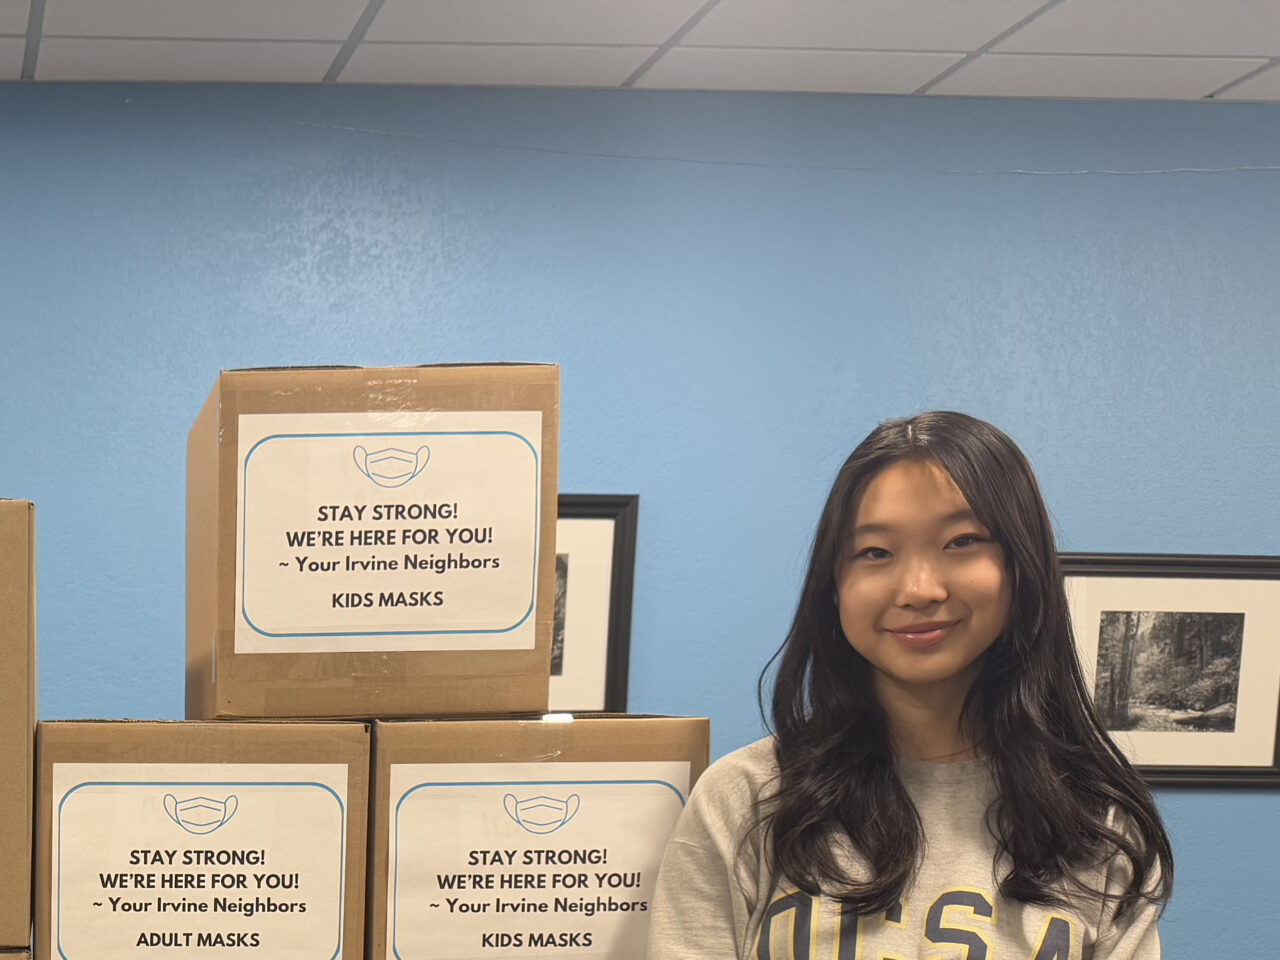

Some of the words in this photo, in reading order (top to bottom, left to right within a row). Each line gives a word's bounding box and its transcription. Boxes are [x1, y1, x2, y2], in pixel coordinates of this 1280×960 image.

[317, 504, 368, 522] STAY
[371, 502, 458, 521] STRONG!
[285, 530, 345, 548] WE'RE
[349, 529, 397, 547] HERE
[401, 528, 440, 546] FOR
[445, 526, 493, 545] YOU!
[295, 555, 341, 573] Your
[345, 554, 399, 572] Irvine
[403, 552, 500, 575] Neighbors
[331, 592, 374, 609] KIDS
[378, 590, 444, 608] MASKS
[129, 849, 178, 866] STAY
[181, 849, 266, 866] STRONG!
[467, 849, 518, 866] STAY
[521, 848, 607, 866] STRONG!
[98, 873, 156, 889] WE'RE
[160, 873, 206, 889] HERE
[211, 873, 249, 890] FOR
[252, 872, 299, 890] YOU!
[436, 873, 495, 890] WE'RE
[499, 873, 547, 890] HERE
[551, 873, 590, 889] FOR
[594, 871, 641, 889] YOU!
[107, 896, 153, 913] Your
[157, 896, 209, 913] Irvine
[213, 896, 307, 918] Neighbors
[445, 897, 491, 914] Your
[495, 897, 549, 913] Irvine
[553, 895, 648, 917] Neighbors
[135, 932, 193, 948] ADULT
[196, 932, 260, 948] MASKS
[481, 932, 524, 948] KIDS
[527, 932, 593, 948] MASKS
